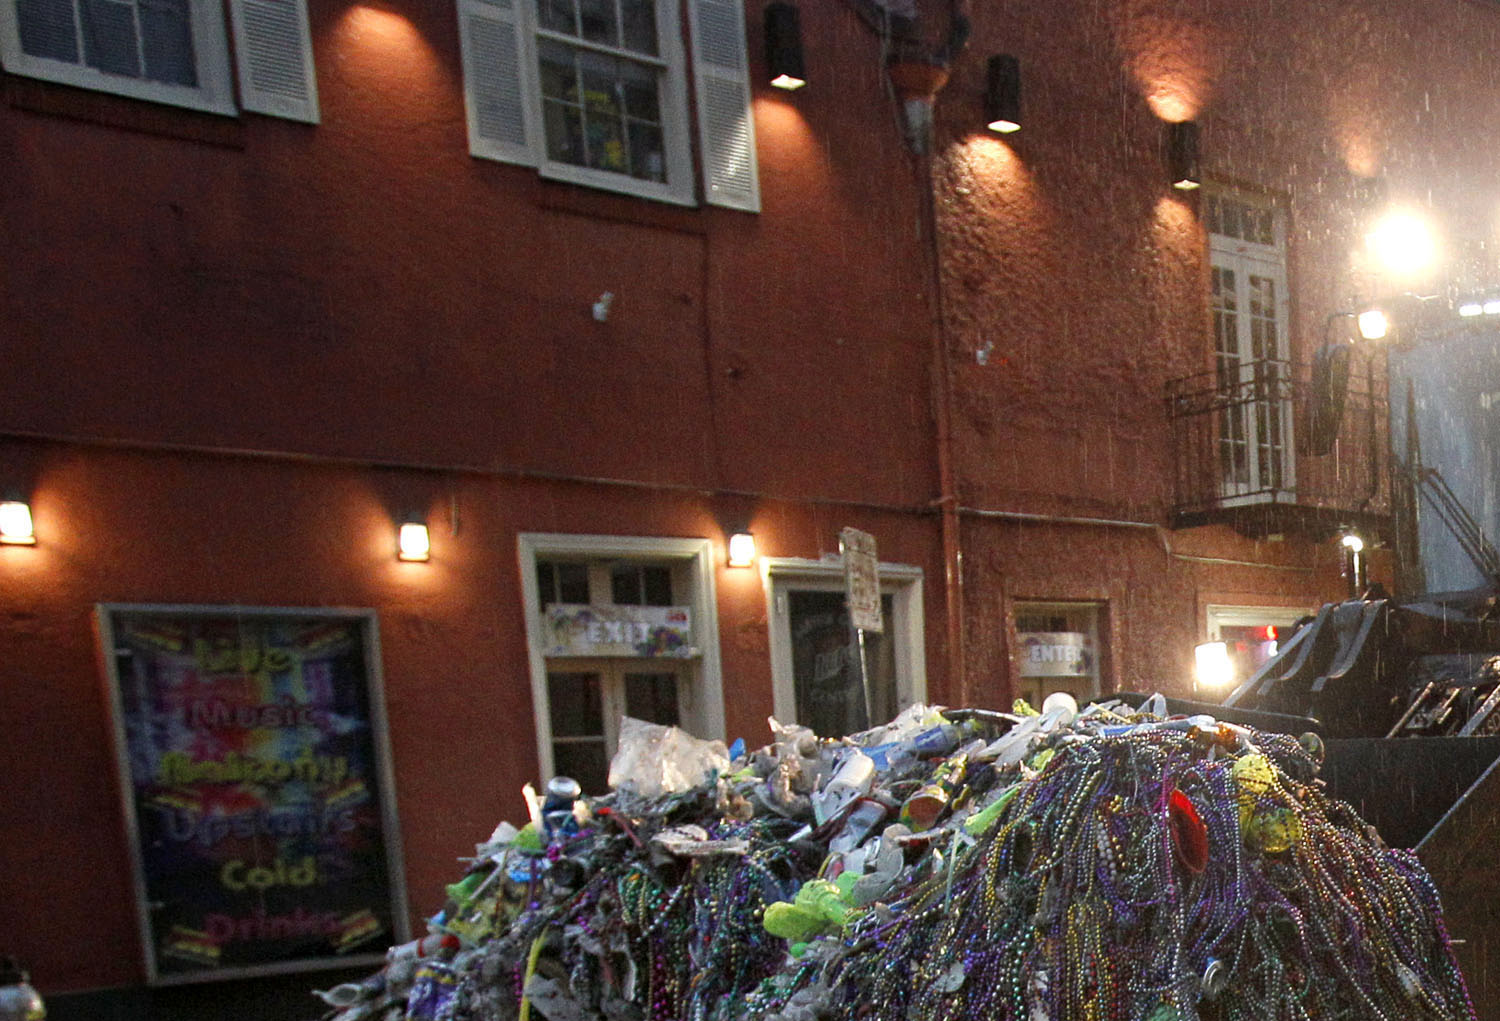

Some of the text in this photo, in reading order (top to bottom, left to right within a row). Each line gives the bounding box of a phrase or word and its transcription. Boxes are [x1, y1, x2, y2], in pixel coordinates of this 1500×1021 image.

[586, 621, 651, 644] EXIT
[192, 638, 292, 673] Live
[1030, 644, 1082, 662] ENTER
[184, 697, 319, 729] Music
[165, 806, 356, 845] Upstairs
[221, 856, 317, 890] Cold
[204, 907, 340, 943] Drinks
